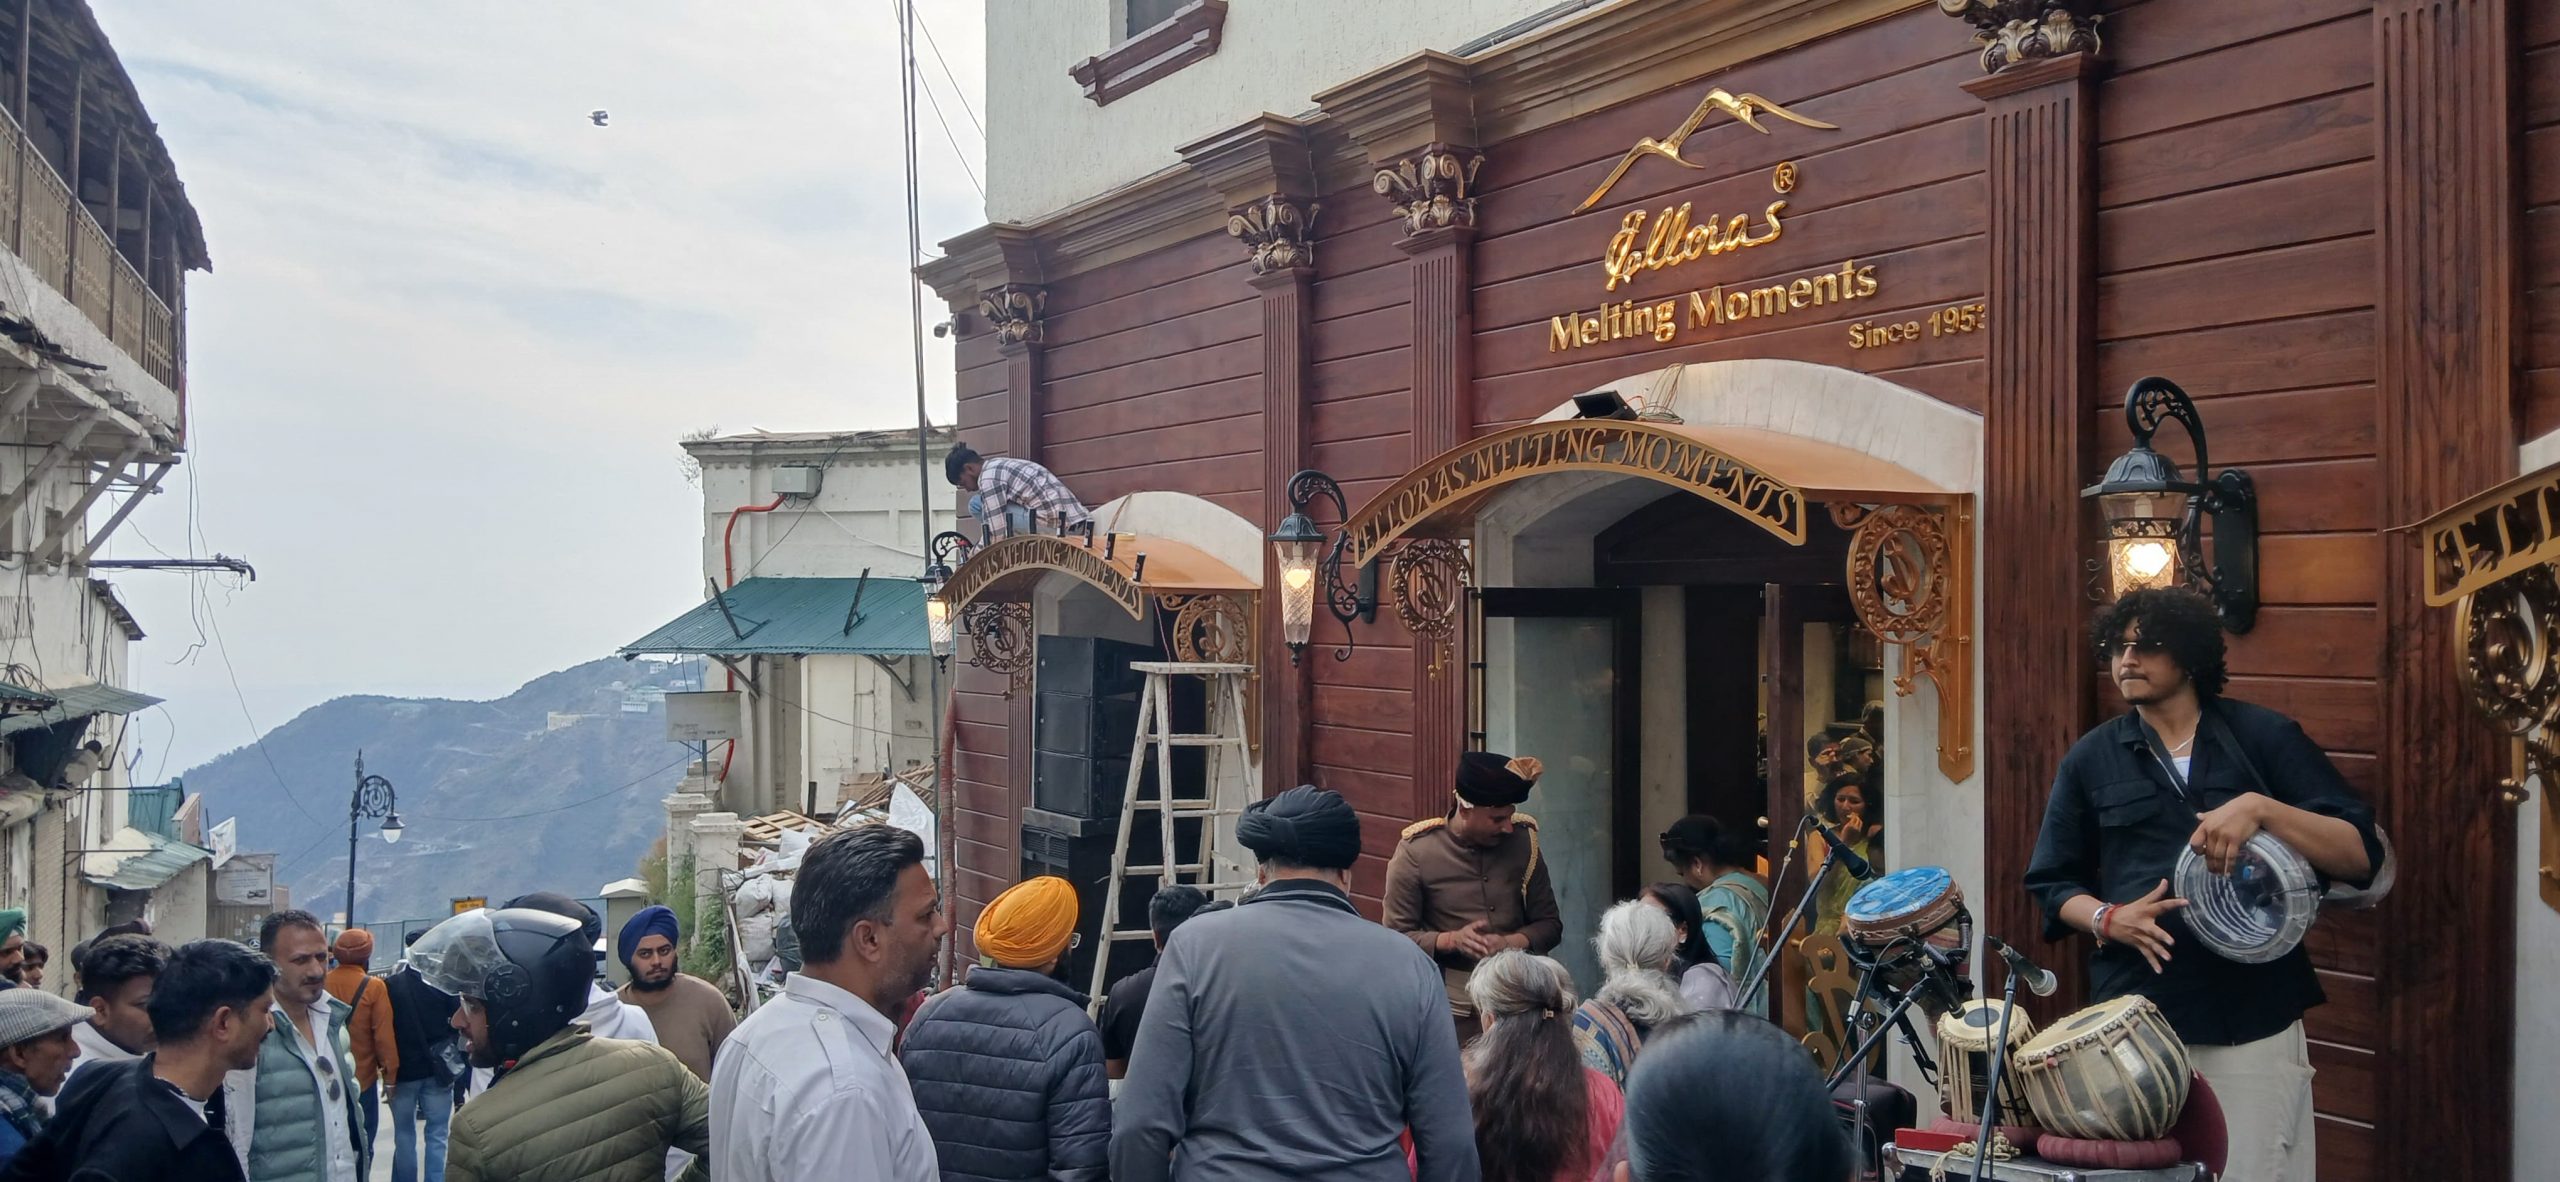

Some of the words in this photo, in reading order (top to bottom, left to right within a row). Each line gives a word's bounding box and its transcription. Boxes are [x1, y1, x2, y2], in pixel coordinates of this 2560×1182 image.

[1550, 299, 1677, 353] Melting
[1687, 260, 1879, 330] Moments
[1848, 321, 1921, 349] Since
[1359, 458, 1466, 555] ELLORAS
[1470, 428, 1608, 483] MELTING
[1612, 429, 1798, 527] MOMENTS
[1000, 539, 1061, 571] MELTING
[1062, 543, 1140, 610] MOMENTS
